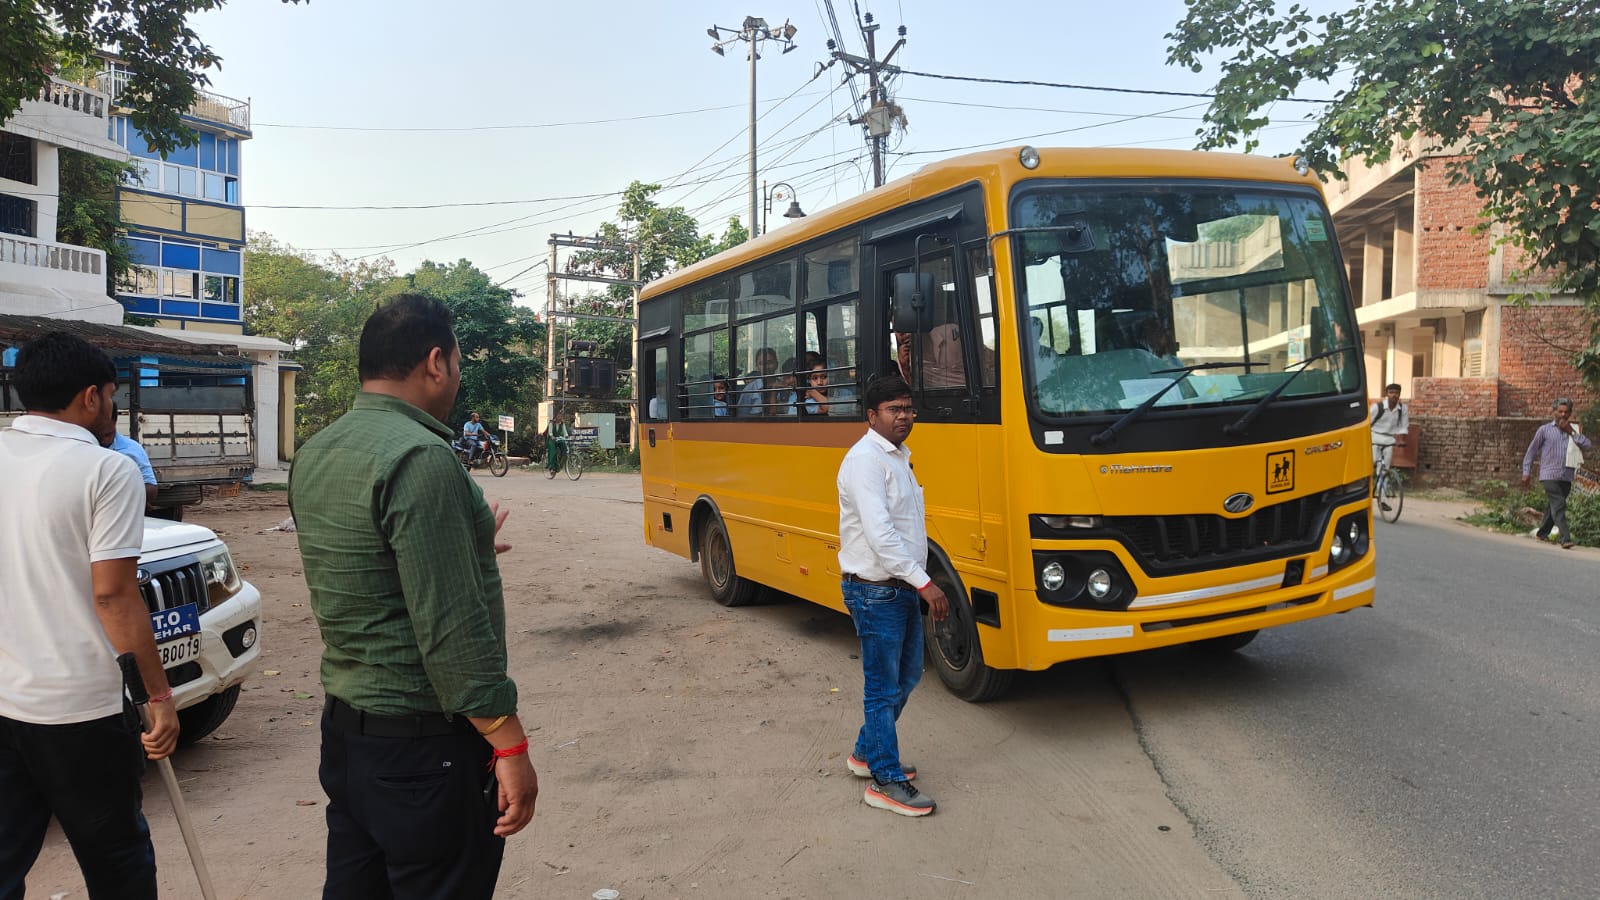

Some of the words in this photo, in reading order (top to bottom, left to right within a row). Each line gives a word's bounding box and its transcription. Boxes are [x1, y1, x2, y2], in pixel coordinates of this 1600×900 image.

[152, 611, 180, 630] T.O
[154, 623, 192, 640] EHAR
[159, 638, 200, 665] B0019
